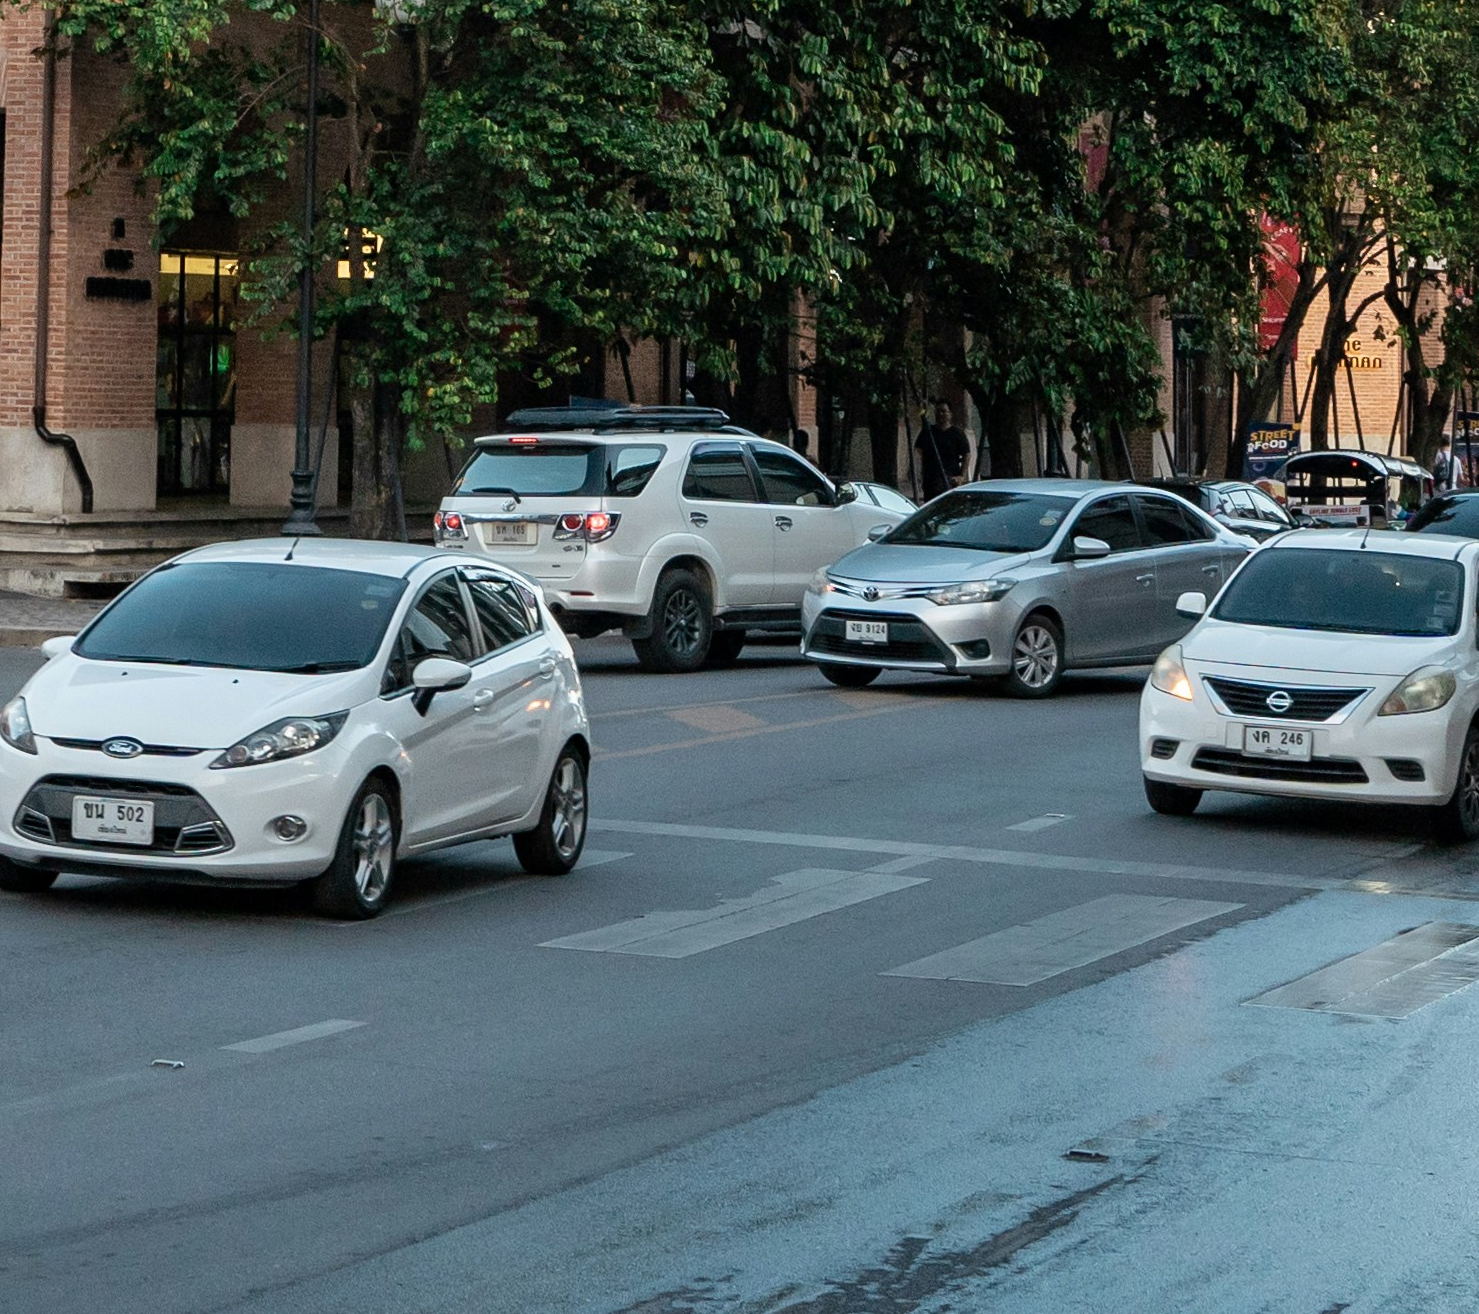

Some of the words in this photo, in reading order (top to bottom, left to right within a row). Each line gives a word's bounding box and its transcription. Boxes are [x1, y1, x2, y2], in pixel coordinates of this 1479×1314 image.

[1250, 429, 1295, 442] STREET
[1281, 731, 1304, 745] 246
[117, 805, 144, 823] 502
